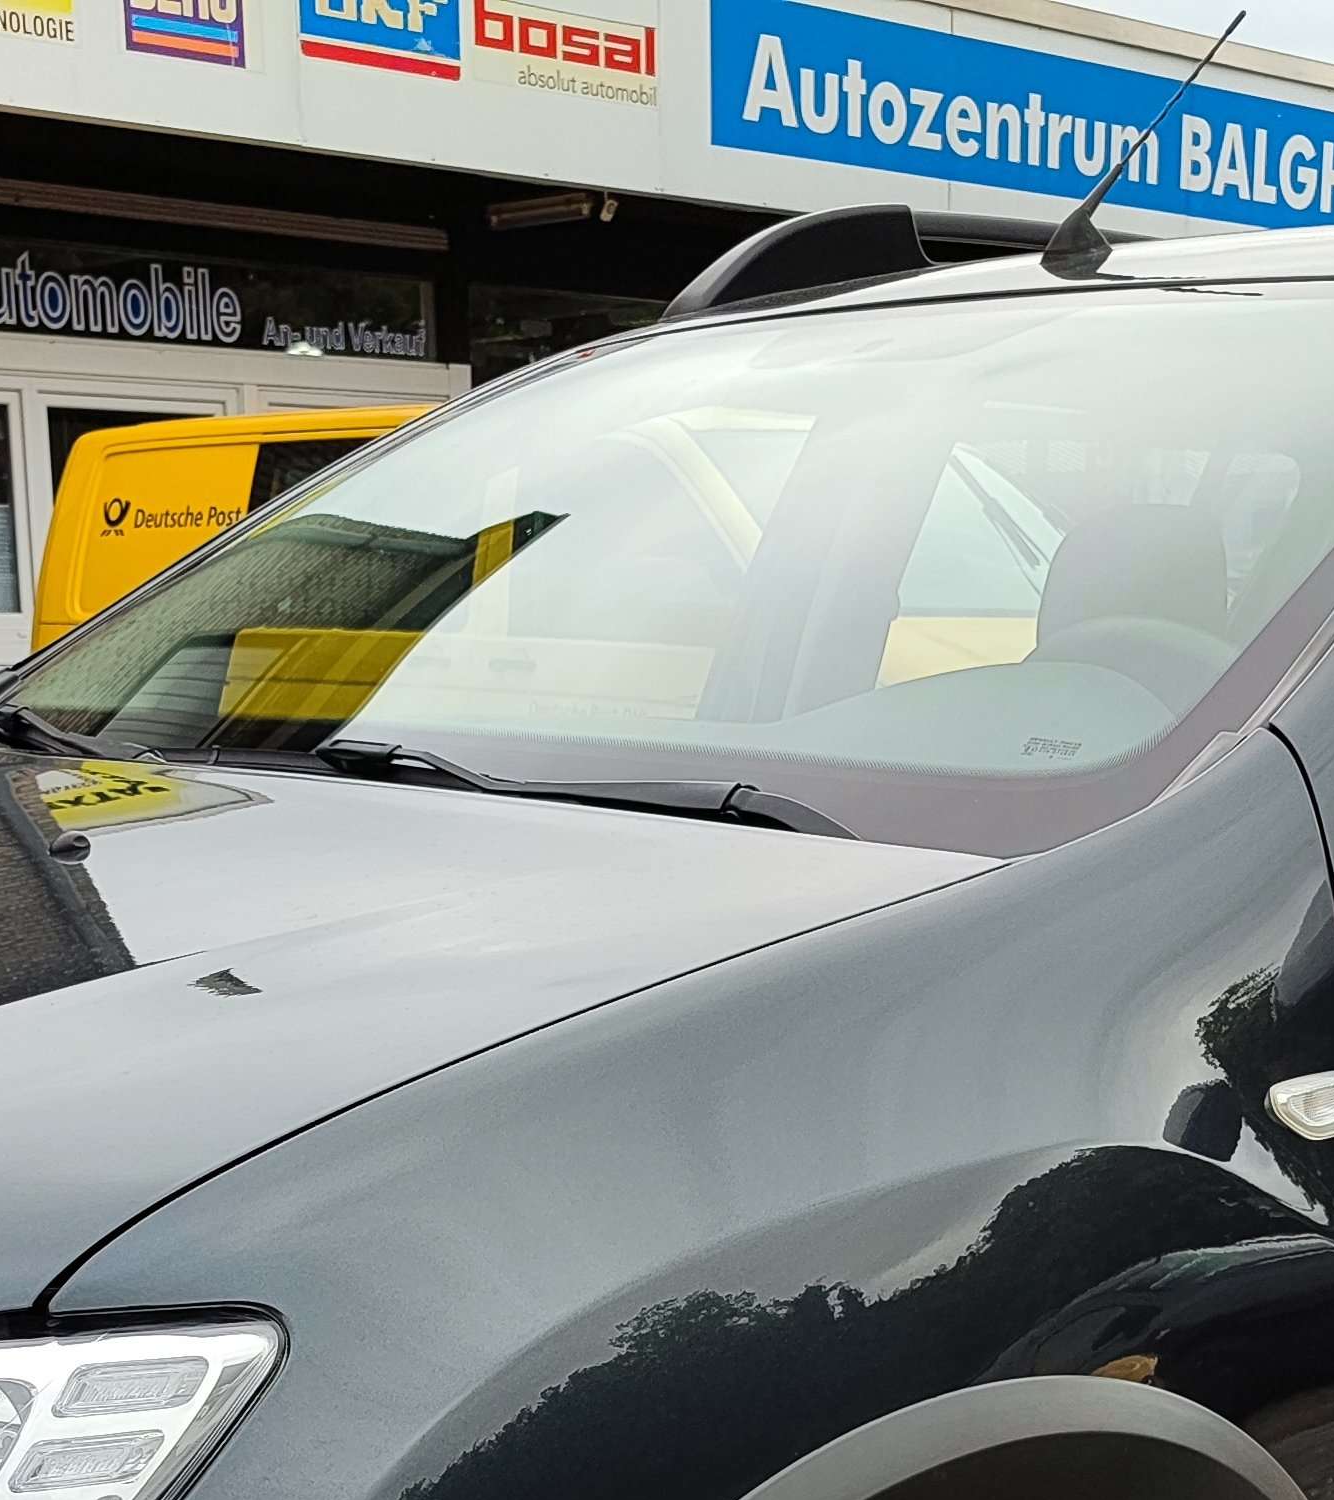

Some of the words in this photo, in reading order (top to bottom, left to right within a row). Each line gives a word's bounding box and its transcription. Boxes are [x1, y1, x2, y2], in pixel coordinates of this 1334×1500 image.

[474, 0, 657, 77] bosal
[517, 66, 578, 95] absolut
[580, 80, 658, 107] automobil
[742, 33, 1159, 186] Autozentrum
[262, 316, 302, 347] An-
[305, 321, 346, 350] und
[347, 319, 427, 358] Verkauf
[134, 505, 204, 529] Deutsche
[207, 505, 242, 527] Post
